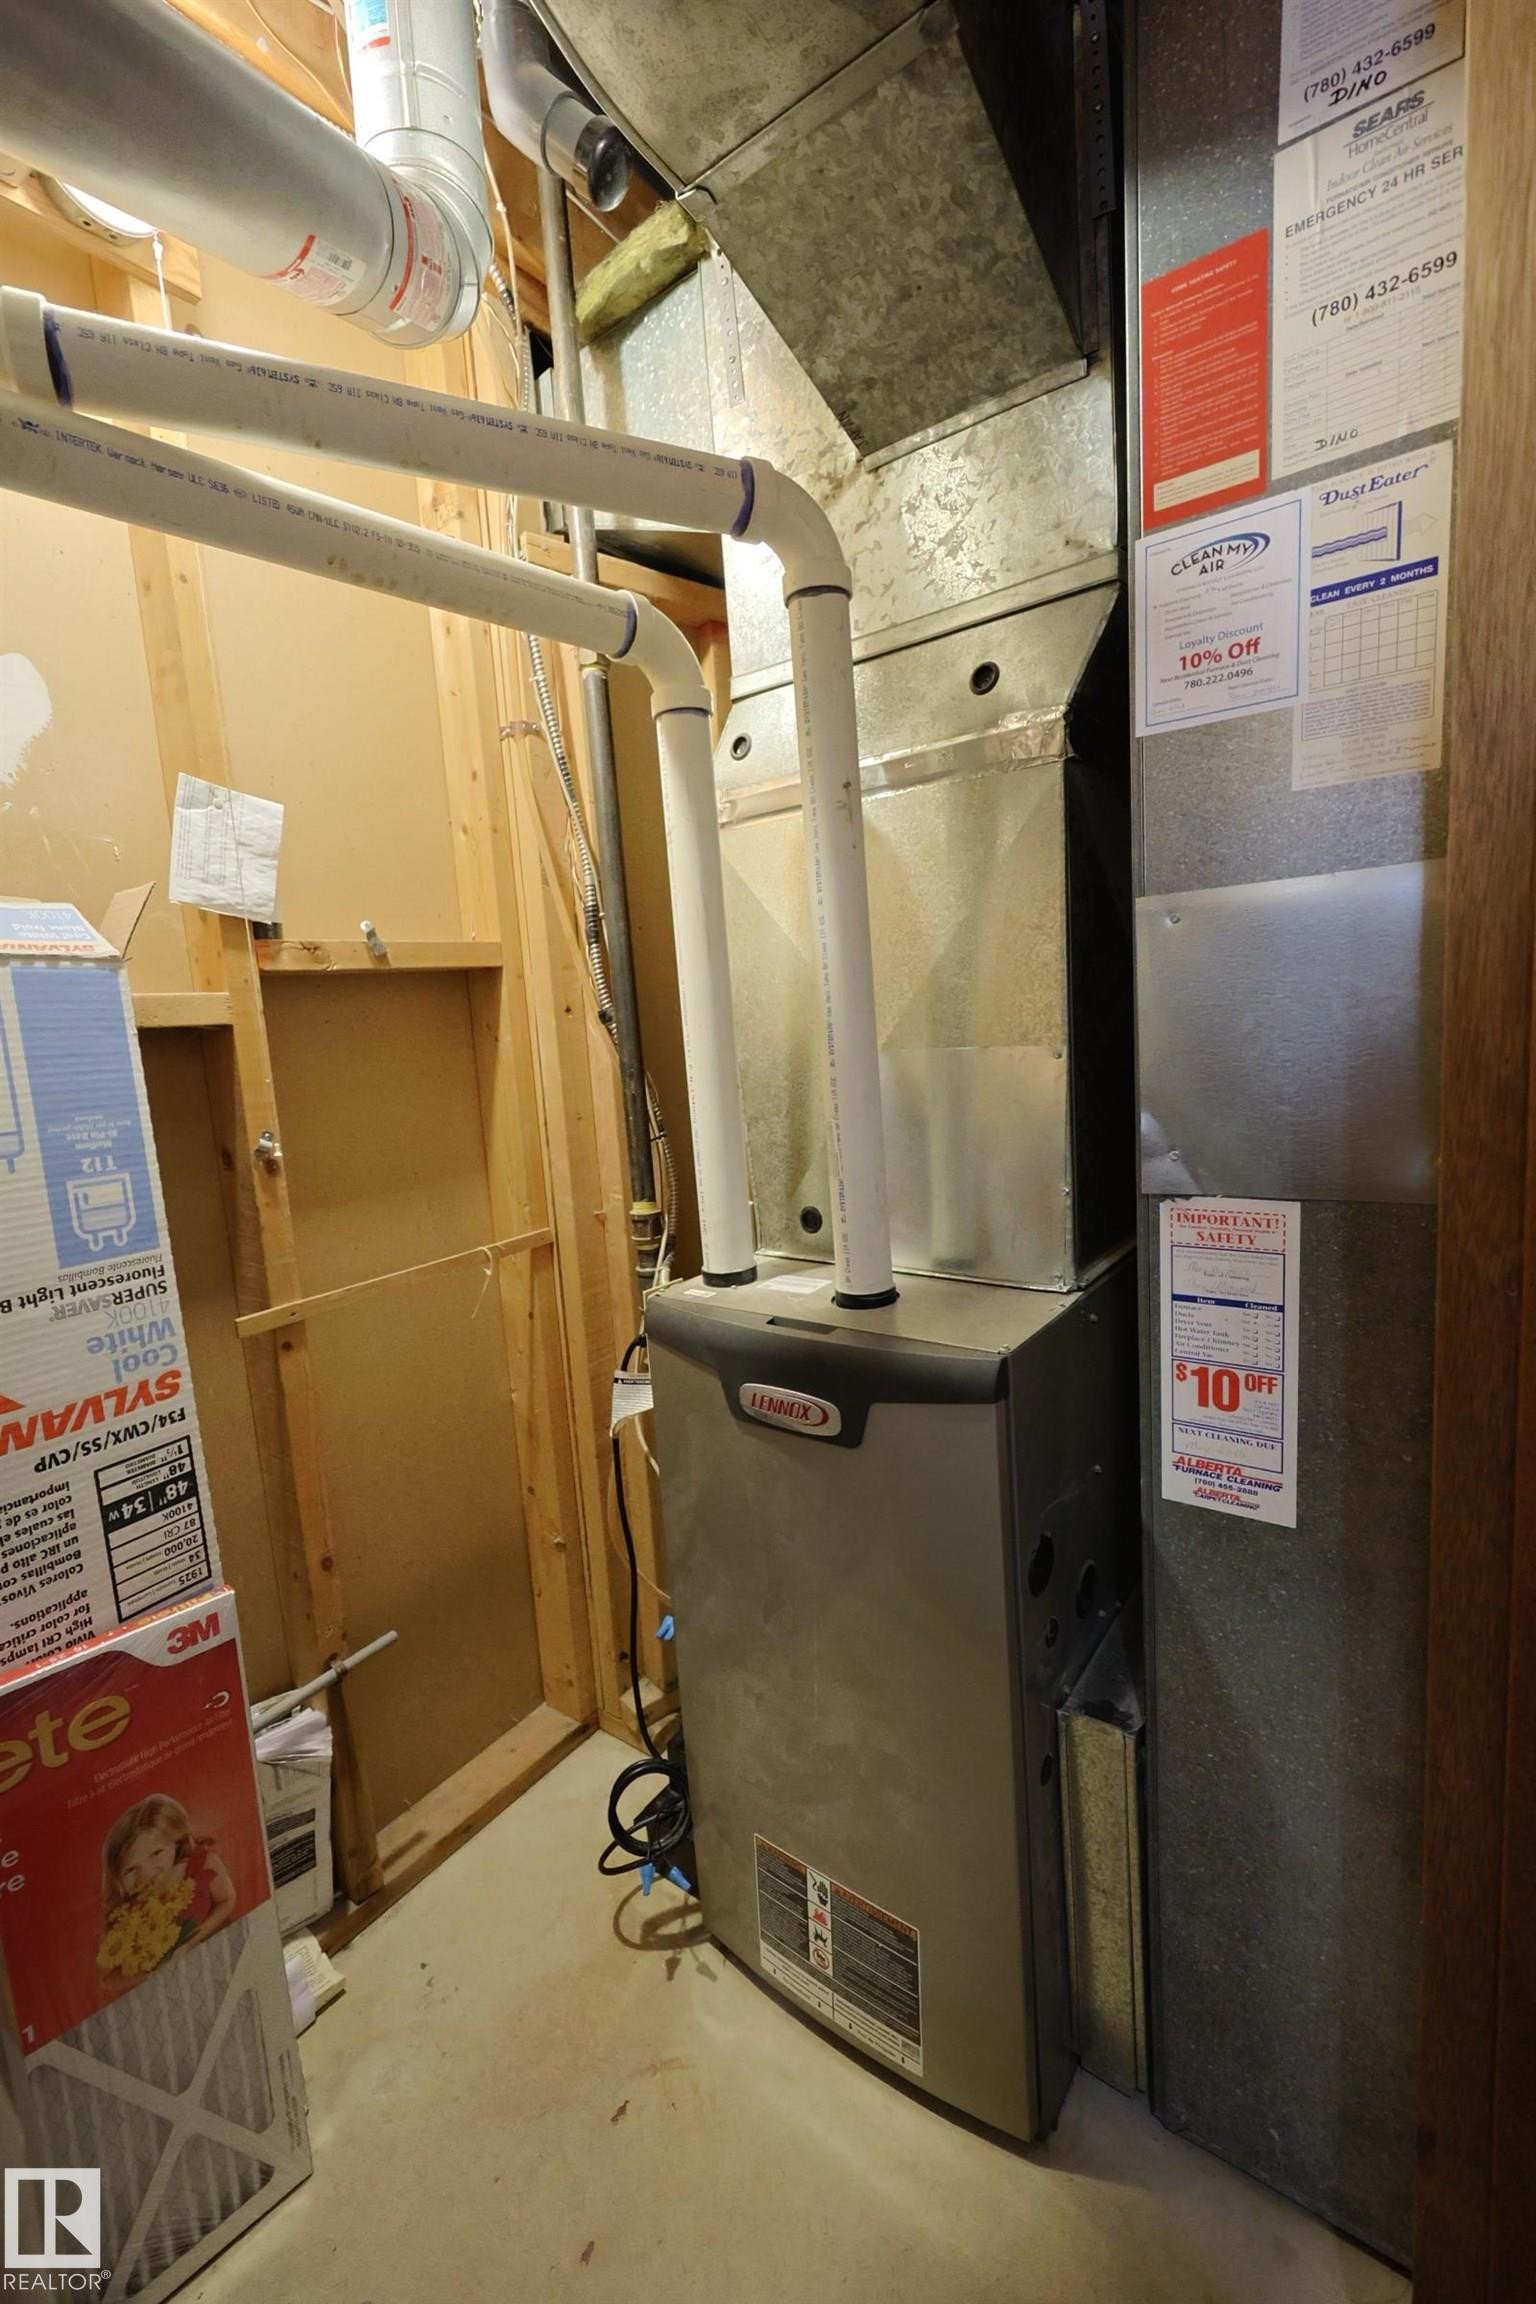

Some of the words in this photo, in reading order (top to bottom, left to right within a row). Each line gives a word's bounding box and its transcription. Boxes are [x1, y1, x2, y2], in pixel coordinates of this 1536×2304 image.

[1304, 66, 1345, 103] (780)
[1352, 21, 1435, 77] 432-6599
[1352, 89, 1424, 139] SEARS
[1348, 106, 1428, 159] HomeCentral
[1285, 184, 1376, 238] EMERGENCY
[1382, 175, 1398, 193] 24
[1403, 162, 1425, 183] HR
[1312, 291, 1358, 327] (780)
[1364, 249, 1457, 302] 432-6599
[56, 430, 103, 455] INTERTEK
[107, 447, 145, 469] Warnock
[1170, 544, 1222, 577] CLEAN
[1226, 536, 1253, 560] MY
[1198, 558, 1224, 576] AIR
[1311, 588, 1339, 603] CLEAN
[1344, 579, 1375, 594] EVERY
[1379, 576, 1385, 585] 2
[1390, 564, 1433, 582] MONTHS
[1179, 633, 1214, 652] Loyalty
[1217, 619, 1263, 641] Discount
[1179, 646, 1222, 672] 10%
[1228, 635, 1260, 660] Off
[1184, 664, 1253, 691] 780.222.0496
[1176, 1212, 1279, 1229] IMPORTANT!
[1196, 1231, 1255, 1245] SAFETY
[57, 1263, 104, 1282] Bombillas
[109, 1253, 163, 1271] Fluorescente
[68, 1264, 165, 1300] Fluorescent
[18, 1286, 65, 1311] Light
[1245, 1302, 1277, 1311] Cleaned
[107, 1299, 169, 1329] 4100K
[87, 1317, 176, 1356] White
[112, 1343, 179, 1384] Cool
[1244, 1372, 1277, 1395] OFF
[751, 1392, 812, 1421] LENNOX
[33, 1407, 187, 1474] F34/CWX/SS/CVP
[1177, 1426, 1202, 1436] NEXT
[1205, 1431, 1253, 1446] CLEANING
[1175, 1454, 1241, 1476] ALBERTA
[1173, 1464, 1223, 1480] FURNACE
[1226, 1475, 1282, 1493] CLEANING
[41, 1493, 72, 1515] color
[157, 1477, 189, 1506] 48"
[5, 1513, 20, 1530] de
[24, 1507, 38, 1520] es
[56, 1507, 74, 1525] las
[161, 1500, 193, 1522] 4100K
[183, 1517, 196, 1530] 87
[1, 1518, 76, 1563] aplicaciones
[14, 1515, 54, 1542] cuales
[163, 1524, 180, 1539] CRI
[40, 1542, 60, 1560] IRC
[62, 1534, 78, 1549] un
[163, 1532, 198, 1557] 20,000
[12, 1552, 37, 1572] alto
[20, 1547, 81, 1584] Bombillas
[188, 1549, 201, 1563] 34
[39, 1560, 83, 1591] Colores
[177, 1565, 202, 1586] 1925
[10, 1586, 88, 1635] applications.
[72, 1601, 90, 1619] for
[39, 1611, 70, 1635] color
[64, 1612, 92, 1637] High
[167, 1612, 221, 1656] 3M
[41, 1630, 61, 1648] CRI
[0, 1638, 38, 1670] lamps
